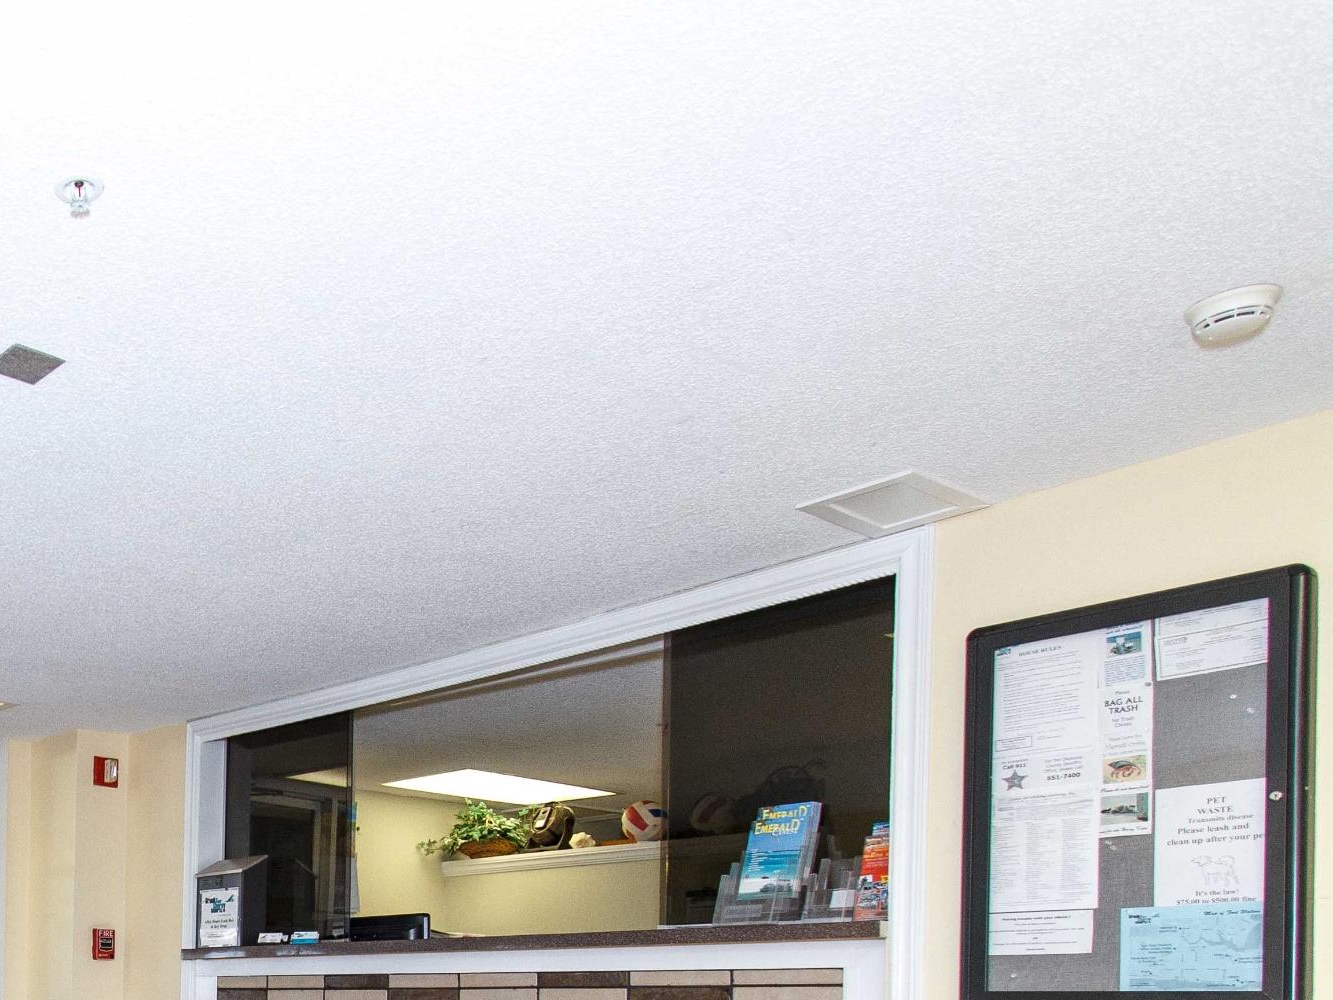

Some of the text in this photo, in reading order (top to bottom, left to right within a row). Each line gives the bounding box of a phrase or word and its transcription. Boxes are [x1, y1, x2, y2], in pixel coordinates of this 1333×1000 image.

[1104, 696, 1143, 707] BAG ALL
[1109, 705, 1138, 714] TRASH
[1197, 806, 1233, 815] WASTE
[754, 819, 800, 835] EMERALD
[1177, 826, 1205, 834] Please
[1207, 824, 1229, 832] leash
[1206, 835, 1227, 843] after
[1229, 835, 1251, 843] your
[1253, 833, 1264, 841] pe
